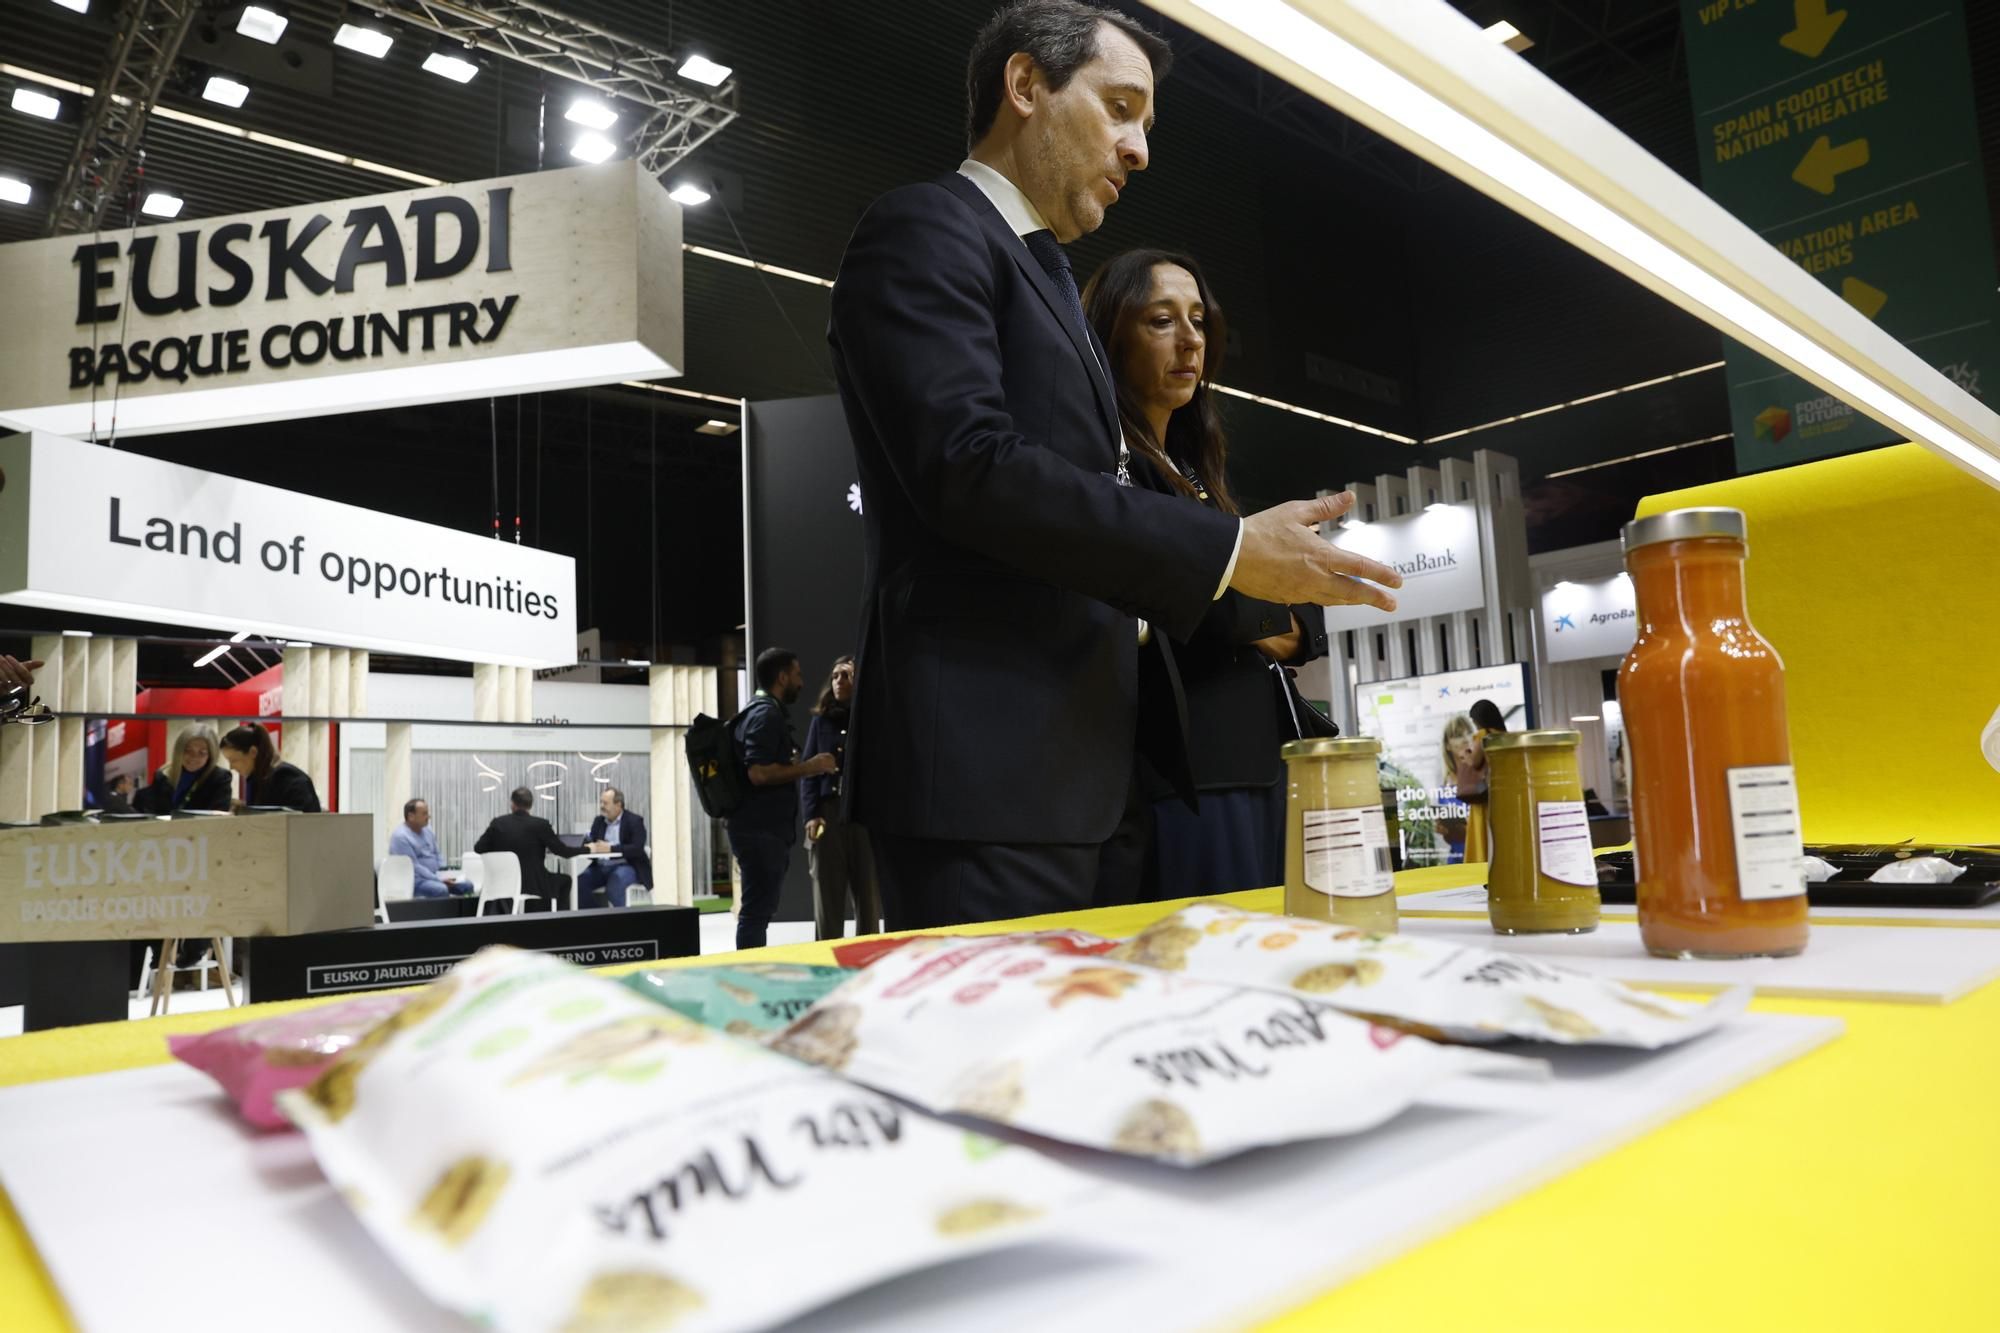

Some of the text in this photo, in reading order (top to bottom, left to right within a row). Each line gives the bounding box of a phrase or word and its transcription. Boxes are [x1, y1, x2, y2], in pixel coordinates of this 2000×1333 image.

[1698, 0, 1729, 25] VIP
[1713, 58, 1884, 143] SPAIN FOODTECH
[1715, 80, 1890, 163] NATION THEATRE
[1860, 201, 1920, 236] AREA
[72, 186, 514, 326] EUSKADI
[69, 294, 519, 389] BASQUE COUNTRY
[109, 496, 560, 620] Land of opportunities
[1392, 548, 1457, 575] ixaBank
[1589, 608, 1636, 625] AgroBa
[1396, 784, 1426, 801] cho
[22, 836, 209, 888] EUSKADI
[20, 895, 212, 923] BASQUE COUNTRY
[323, 968, 370, 985] EUSKO
[601, 947, 645, 961] VASCO
[589, 1134, 803, 1245] Nuts
